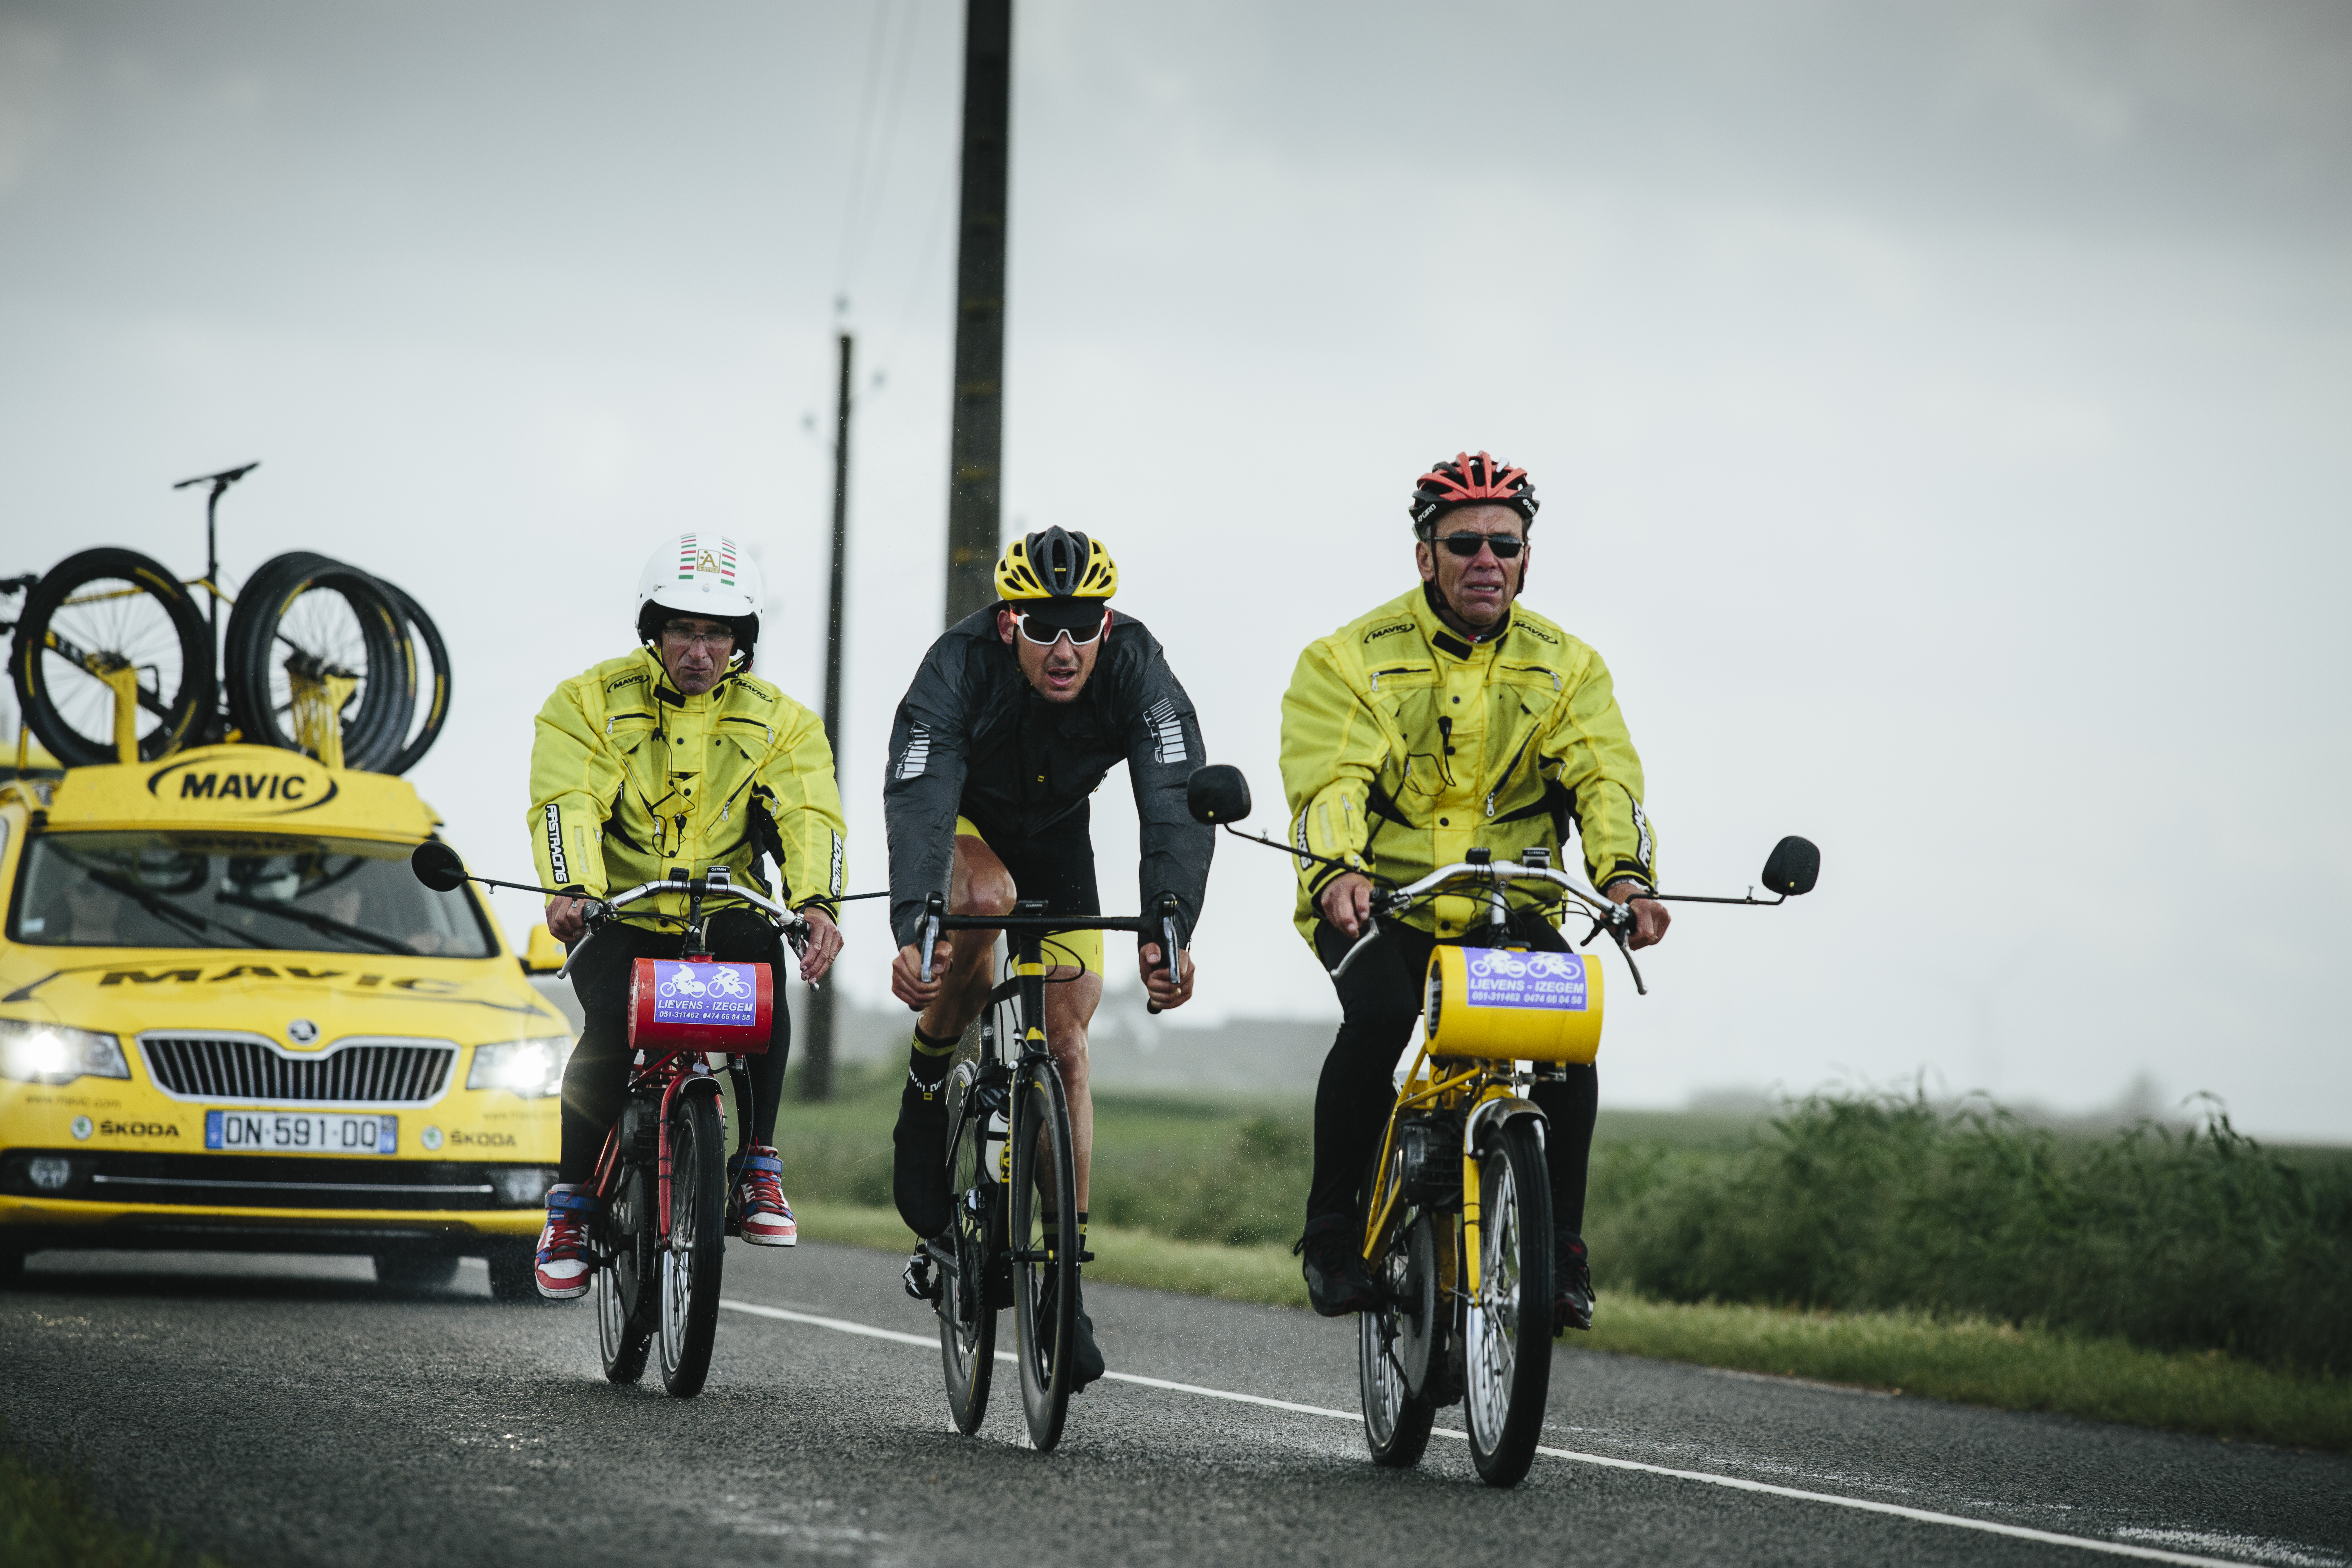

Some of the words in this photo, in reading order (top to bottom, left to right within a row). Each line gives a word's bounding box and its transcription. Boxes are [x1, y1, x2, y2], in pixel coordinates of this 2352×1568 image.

[1372, 624, 1407, 639] MAVIC
[1513, 622, 1550, 640] MAVIC
[614, 675, 644, 689] MAVIC
[736, 680, 767, 699] MAVIC
[180, 773, 306, 800] MAVIC
[546, 804, 568, 882] FIRSTRACING
[98, 965, 463, 995] MAVIC
[1470, 978, 1525, 991] LIEVENS
[1535, 981, 1584, 994] IZEGEM
[658, 999, 704, 1010] LIEVENS
[712, 1001, 753, 1012] IZEGEM
[659, 1011, 699, 1019] 051-311462
[100, 1118, 180, 1137] ŠKODA
